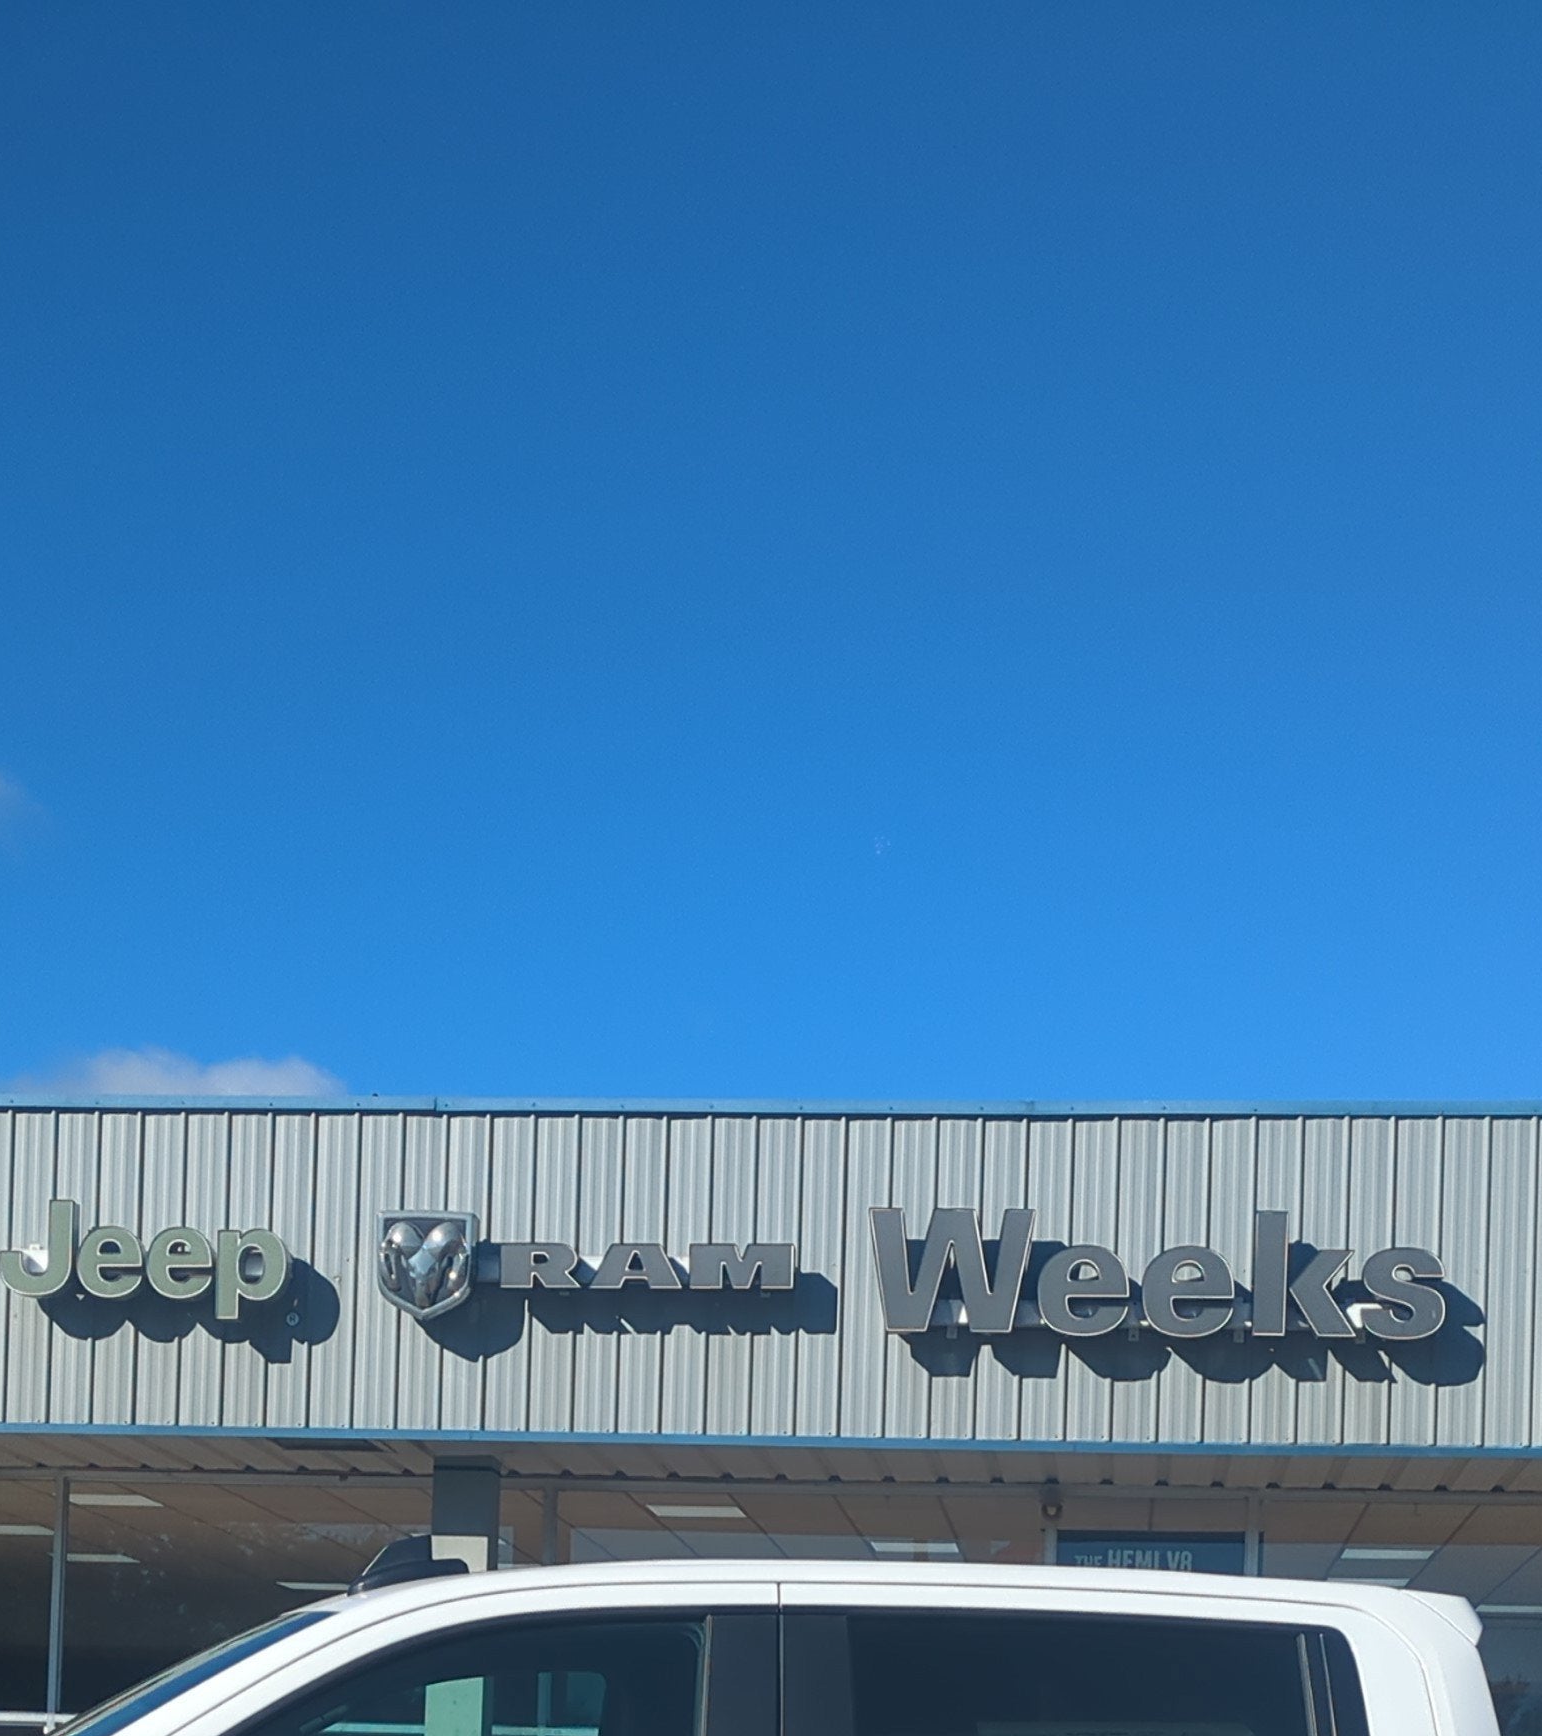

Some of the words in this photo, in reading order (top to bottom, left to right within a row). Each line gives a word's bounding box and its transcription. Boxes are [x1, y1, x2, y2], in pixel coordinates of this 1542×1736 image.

[0, 1200, 292, 1320] Jeep
[500, 1242, 796, 1290] RAM
[869, 1207, 1446, 1341] Weeks
